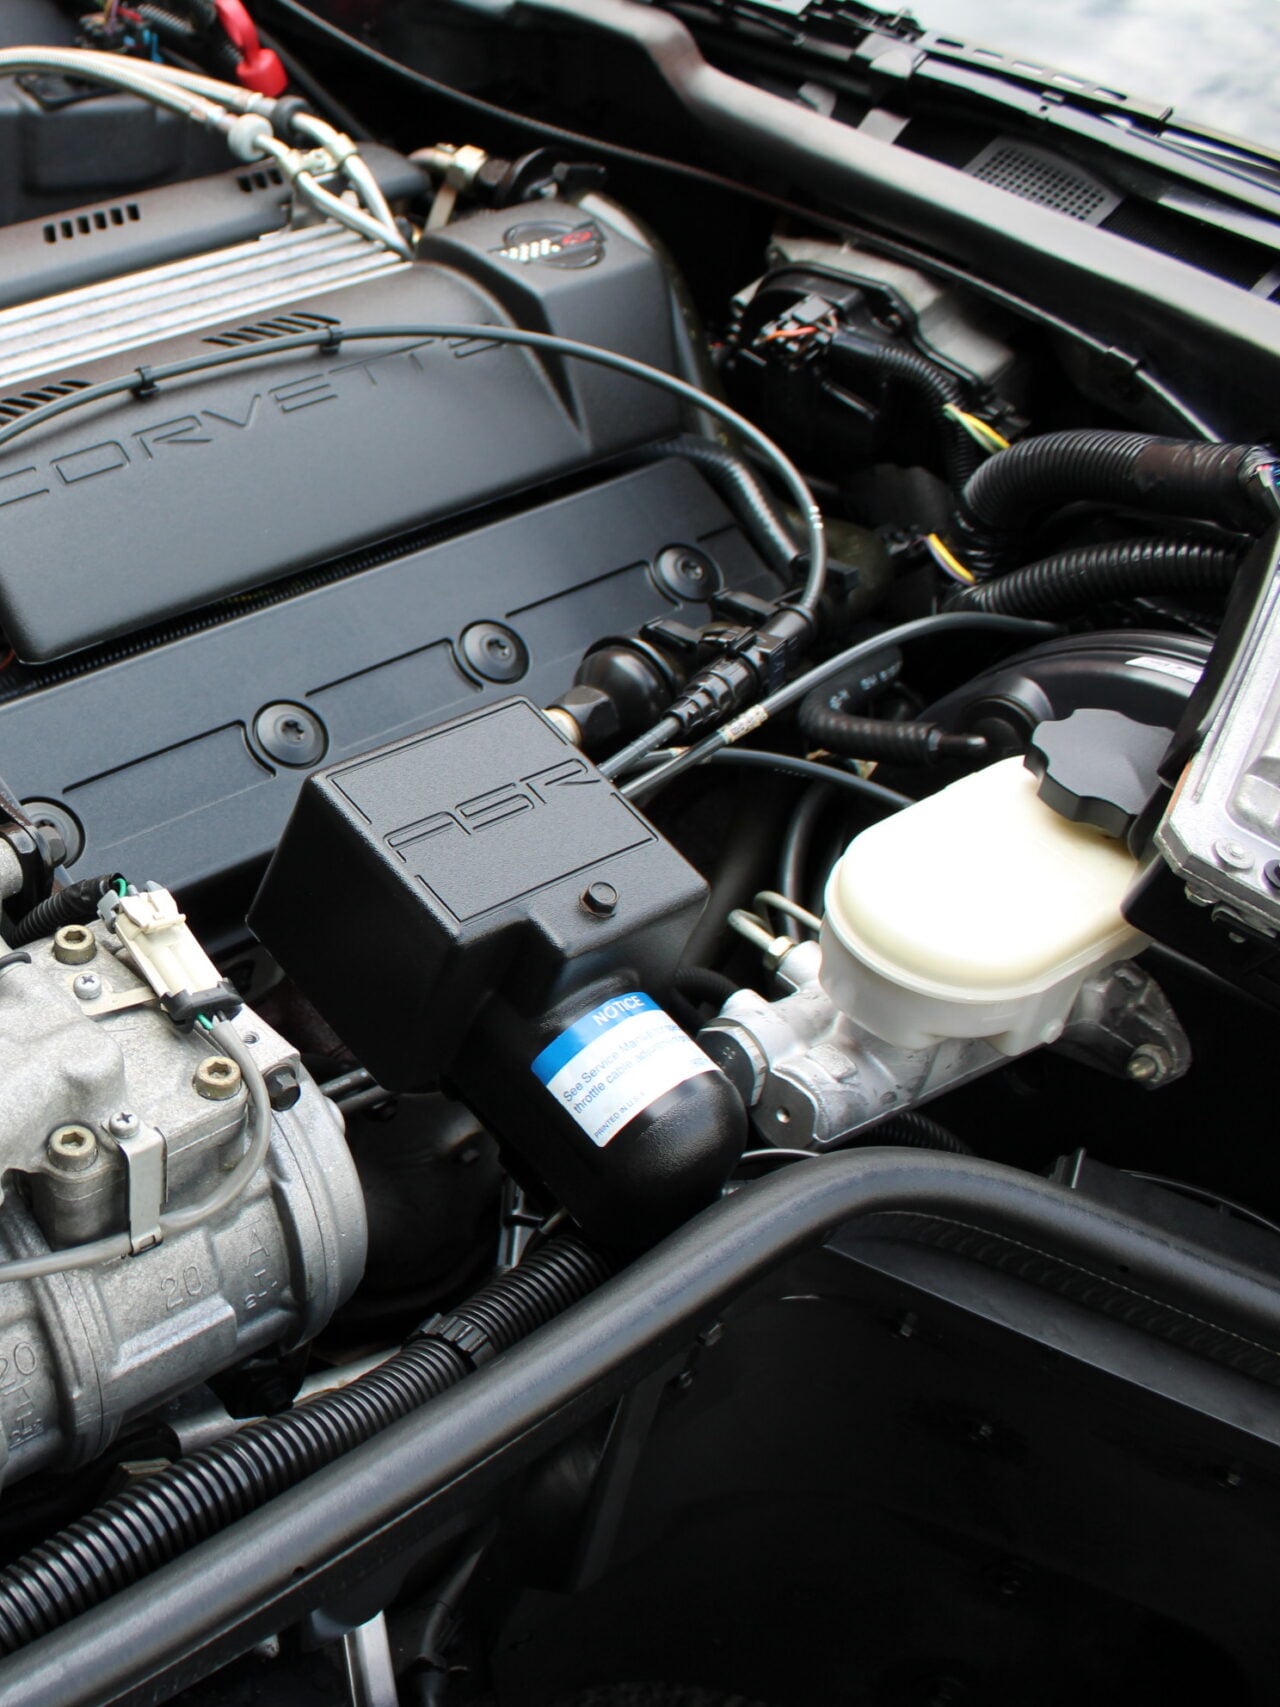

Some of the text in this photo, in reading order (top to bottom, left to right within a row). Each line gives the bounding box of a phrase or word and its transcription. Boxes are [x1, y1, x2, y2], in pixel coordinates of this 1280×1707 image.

[382, 757, 601, 864] ASR
[592, 995, 646, 1027] NOTICE
[562, 1050, 620, 1103] See Service
[573, 1083, 606, 1115] throttle
[594, 1104, 629, 1139] PRINTED IN
[160, 1264, 203, 1312] 20
